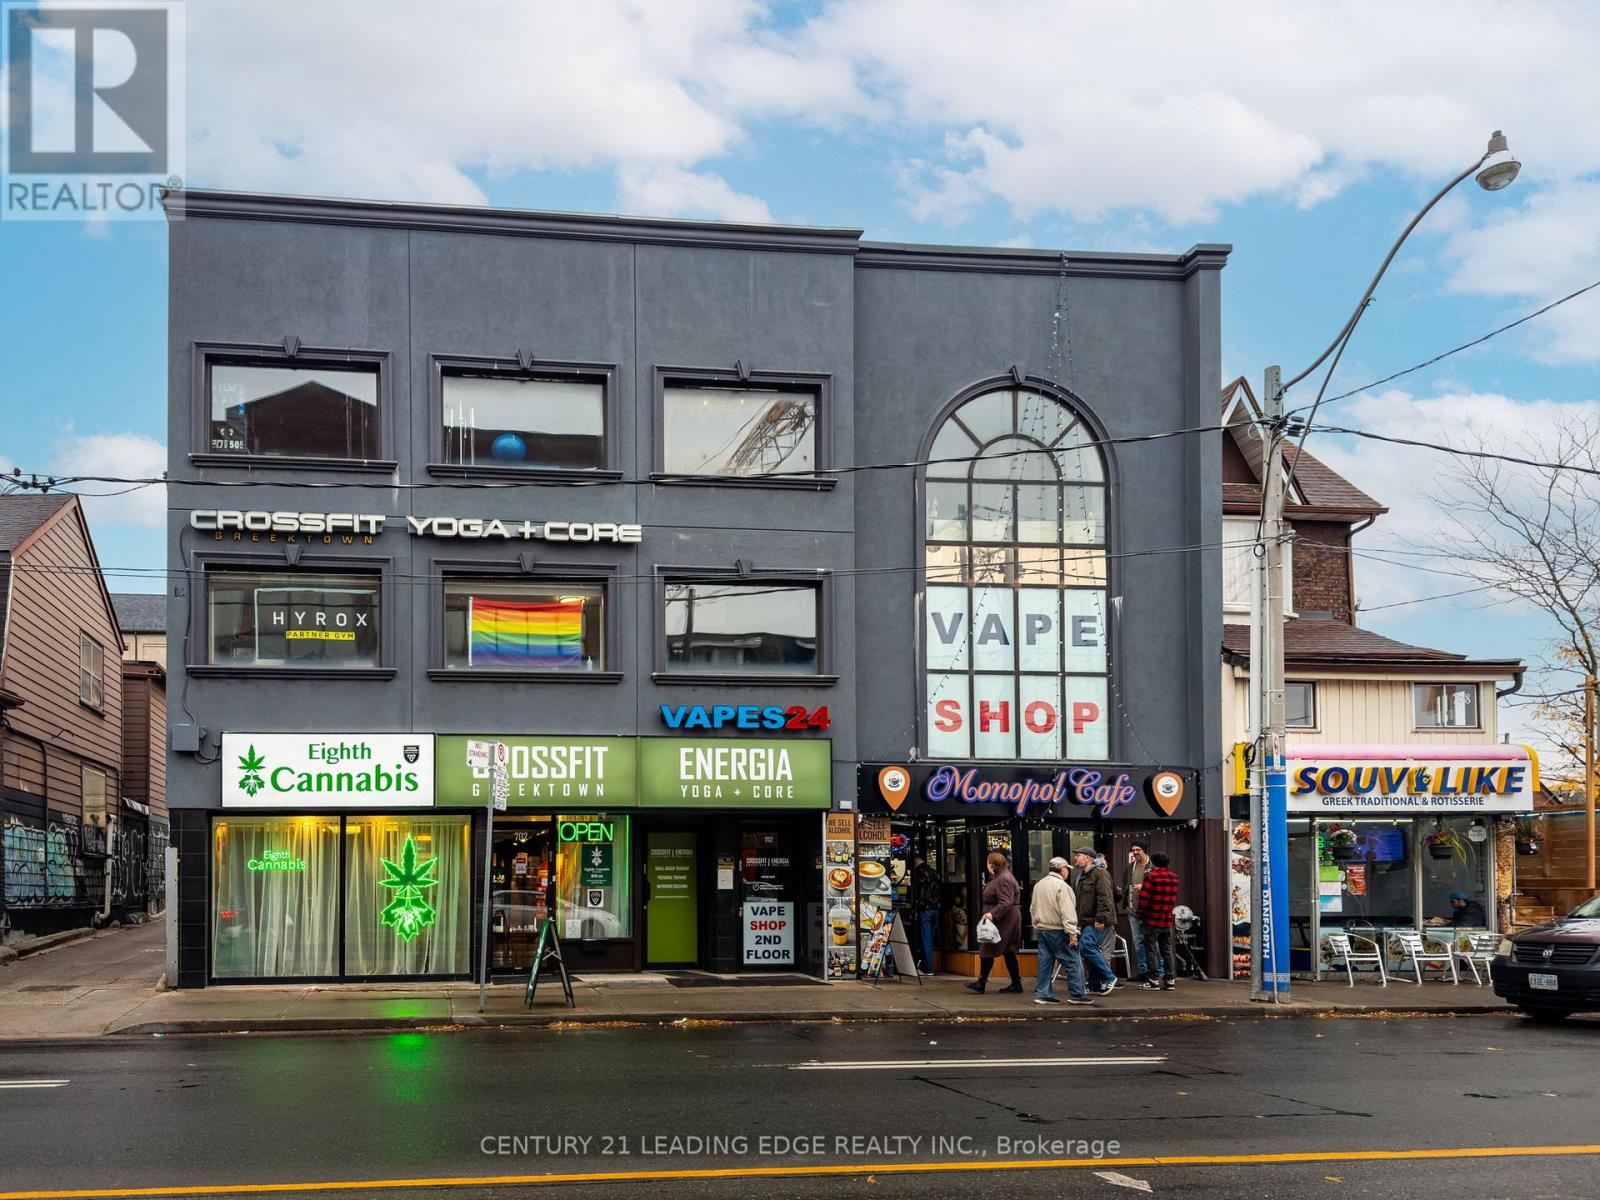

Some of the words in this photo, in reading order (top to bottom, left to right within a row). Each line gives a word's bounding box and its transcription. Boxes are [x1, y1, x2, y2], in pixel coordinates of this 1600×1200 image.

[190, 510, 386, 534] CROSSFIT
[406, 516, 511, 539] YOGA
[518, 520, 536, 540] +
[544, 521, 642, 543] CORE
[214, 532, 374, 544] GREEKTOWN
[272, 612, 367, 626] HYROX
[287, 631, 330, 639] PARTNER
[335, 632, 354, 640] GYM
[931, 611, 1098, 646] VAPE
[660, 704, 831, 730] VAPES24
[934, 699, 1100, 734] SHOP
[308, 742, 371, 764] Eighth
[473, 746, 608, 779] OSSFIT
[680, 748, 793, 780] ENERGIA
[270, 764, 419, 792] Cannabis
[681, 785, 722, 798] YOGA
[753, 785, 794, 799] CORE
[927, 765, 1067, 817] Monopol
[1069, 768, 1136, 816] Cafe
[1322, 797, 1353, 806] GREEK
[1356, 797, 1419, 806] TRADITIONAL
[1422, 797, 1429, 806] &
[1431, 797, 1484, 806] ROTISSERIE
[560, 822, 613, 842] OPEN
[860, 830, 887, 841] LCOHOL
[263, 849, 290, 861] Eighth
[247, 858, 306, 870] Cannabis
[751, 906, 785, 916] VAPE
[750, 920, 786, 931] SHOP
[1262, 890, 1270, 959] DANFORTH
[755, 935, 781, 945] 2ND
[746, 950, 790, 960] FLOOR
